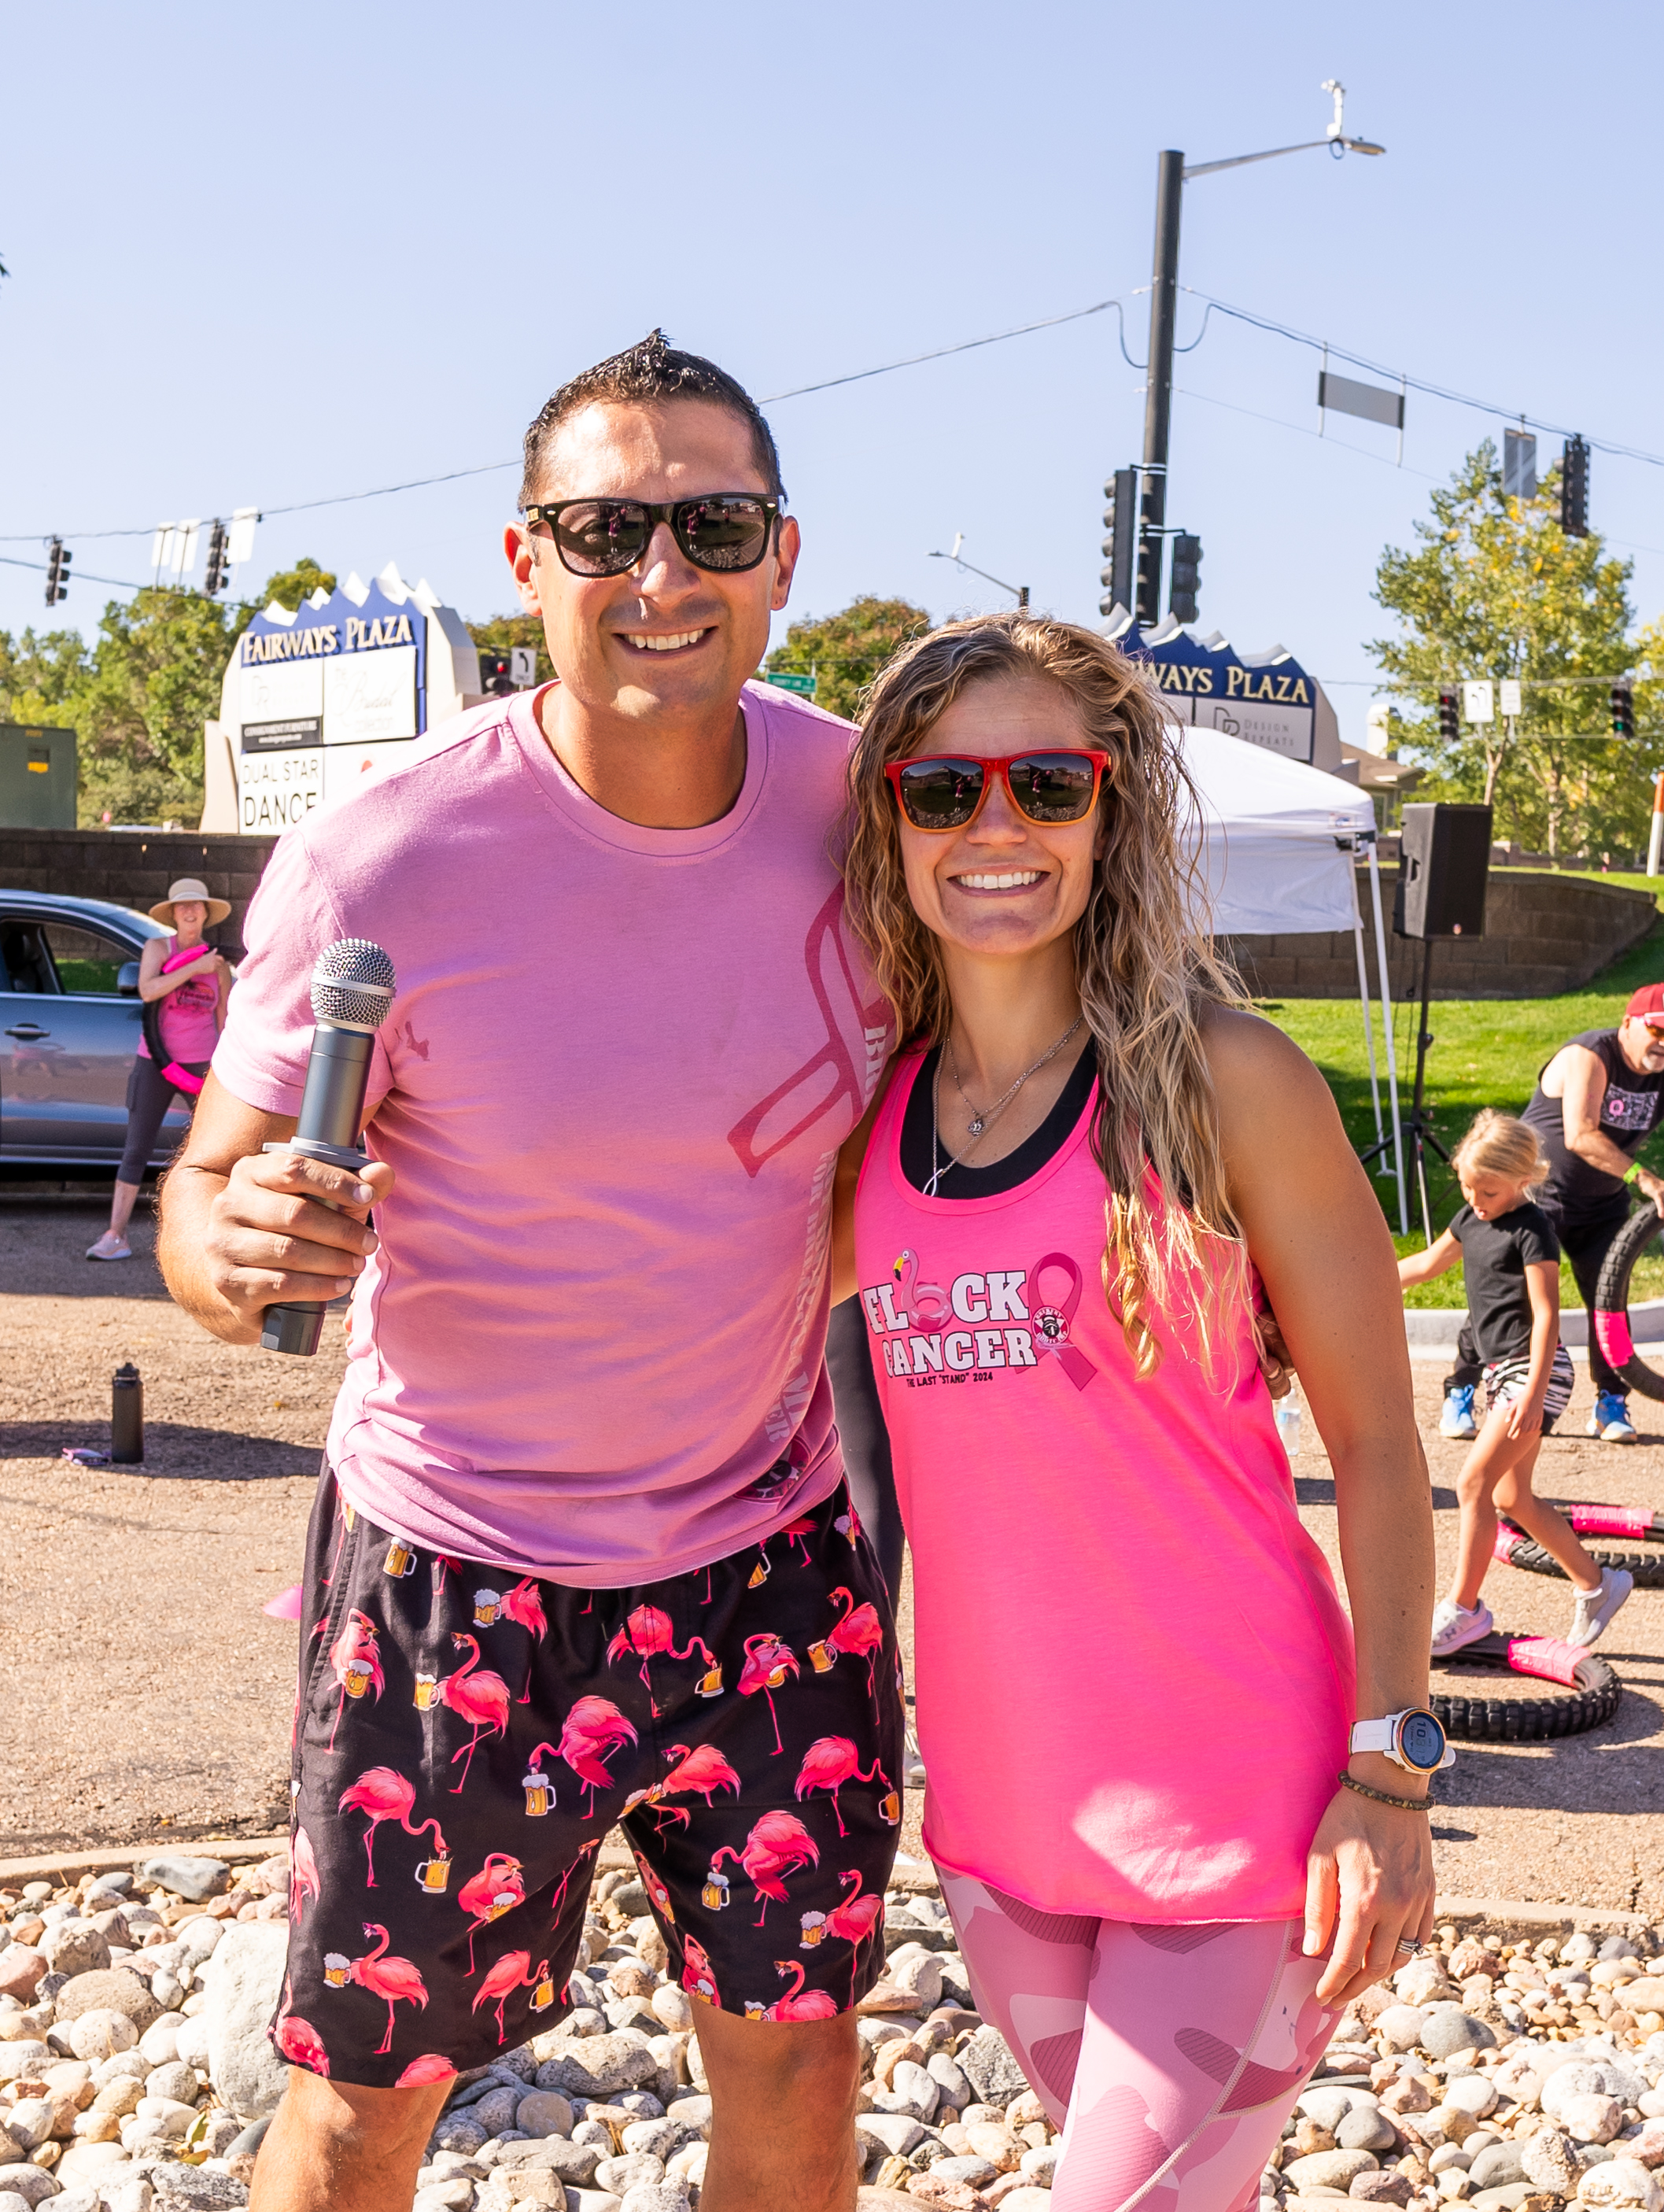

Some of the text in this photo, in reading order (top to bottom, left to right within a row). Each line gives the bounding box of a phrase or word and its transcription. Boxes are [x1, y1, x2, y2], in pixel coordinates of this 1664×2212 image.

[242, 615, 413, 663] FAIRWAYS PLAZA
[1225, 666, 1309, 703] PLAZA
[243, 759, 318, 784] DUAL STAR
[882, 1328, 1038, 1377] CANCER
[917, 1376, 936, 1387] LAST
[972, 1372, 993, 1382] 2024
